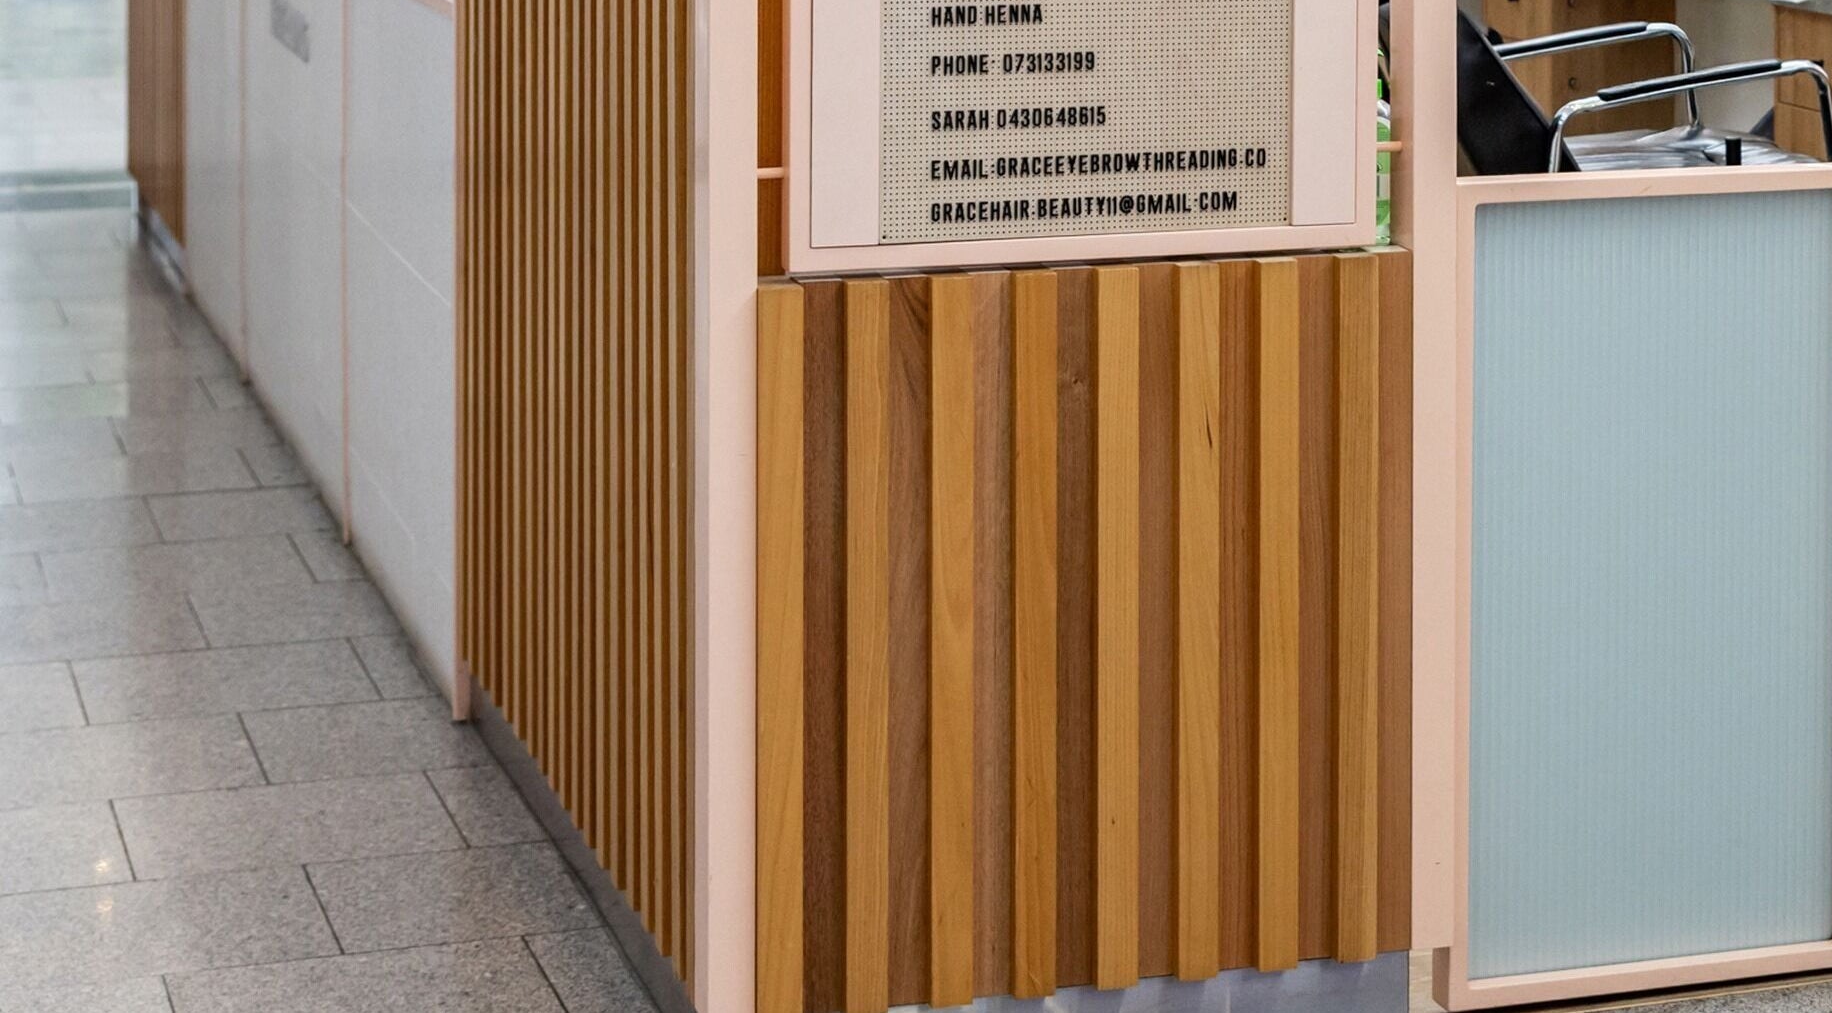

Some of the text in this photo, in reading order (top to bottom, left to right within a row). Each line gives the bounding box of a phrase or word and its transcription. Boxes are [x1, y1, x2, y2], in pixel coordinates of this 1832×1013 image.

[931, 3, 1043, 28] HAND HENNA
[1003, 51, 1096, 73] 073133199
[931, 105, 1107, 132] SARAH 0430648615
